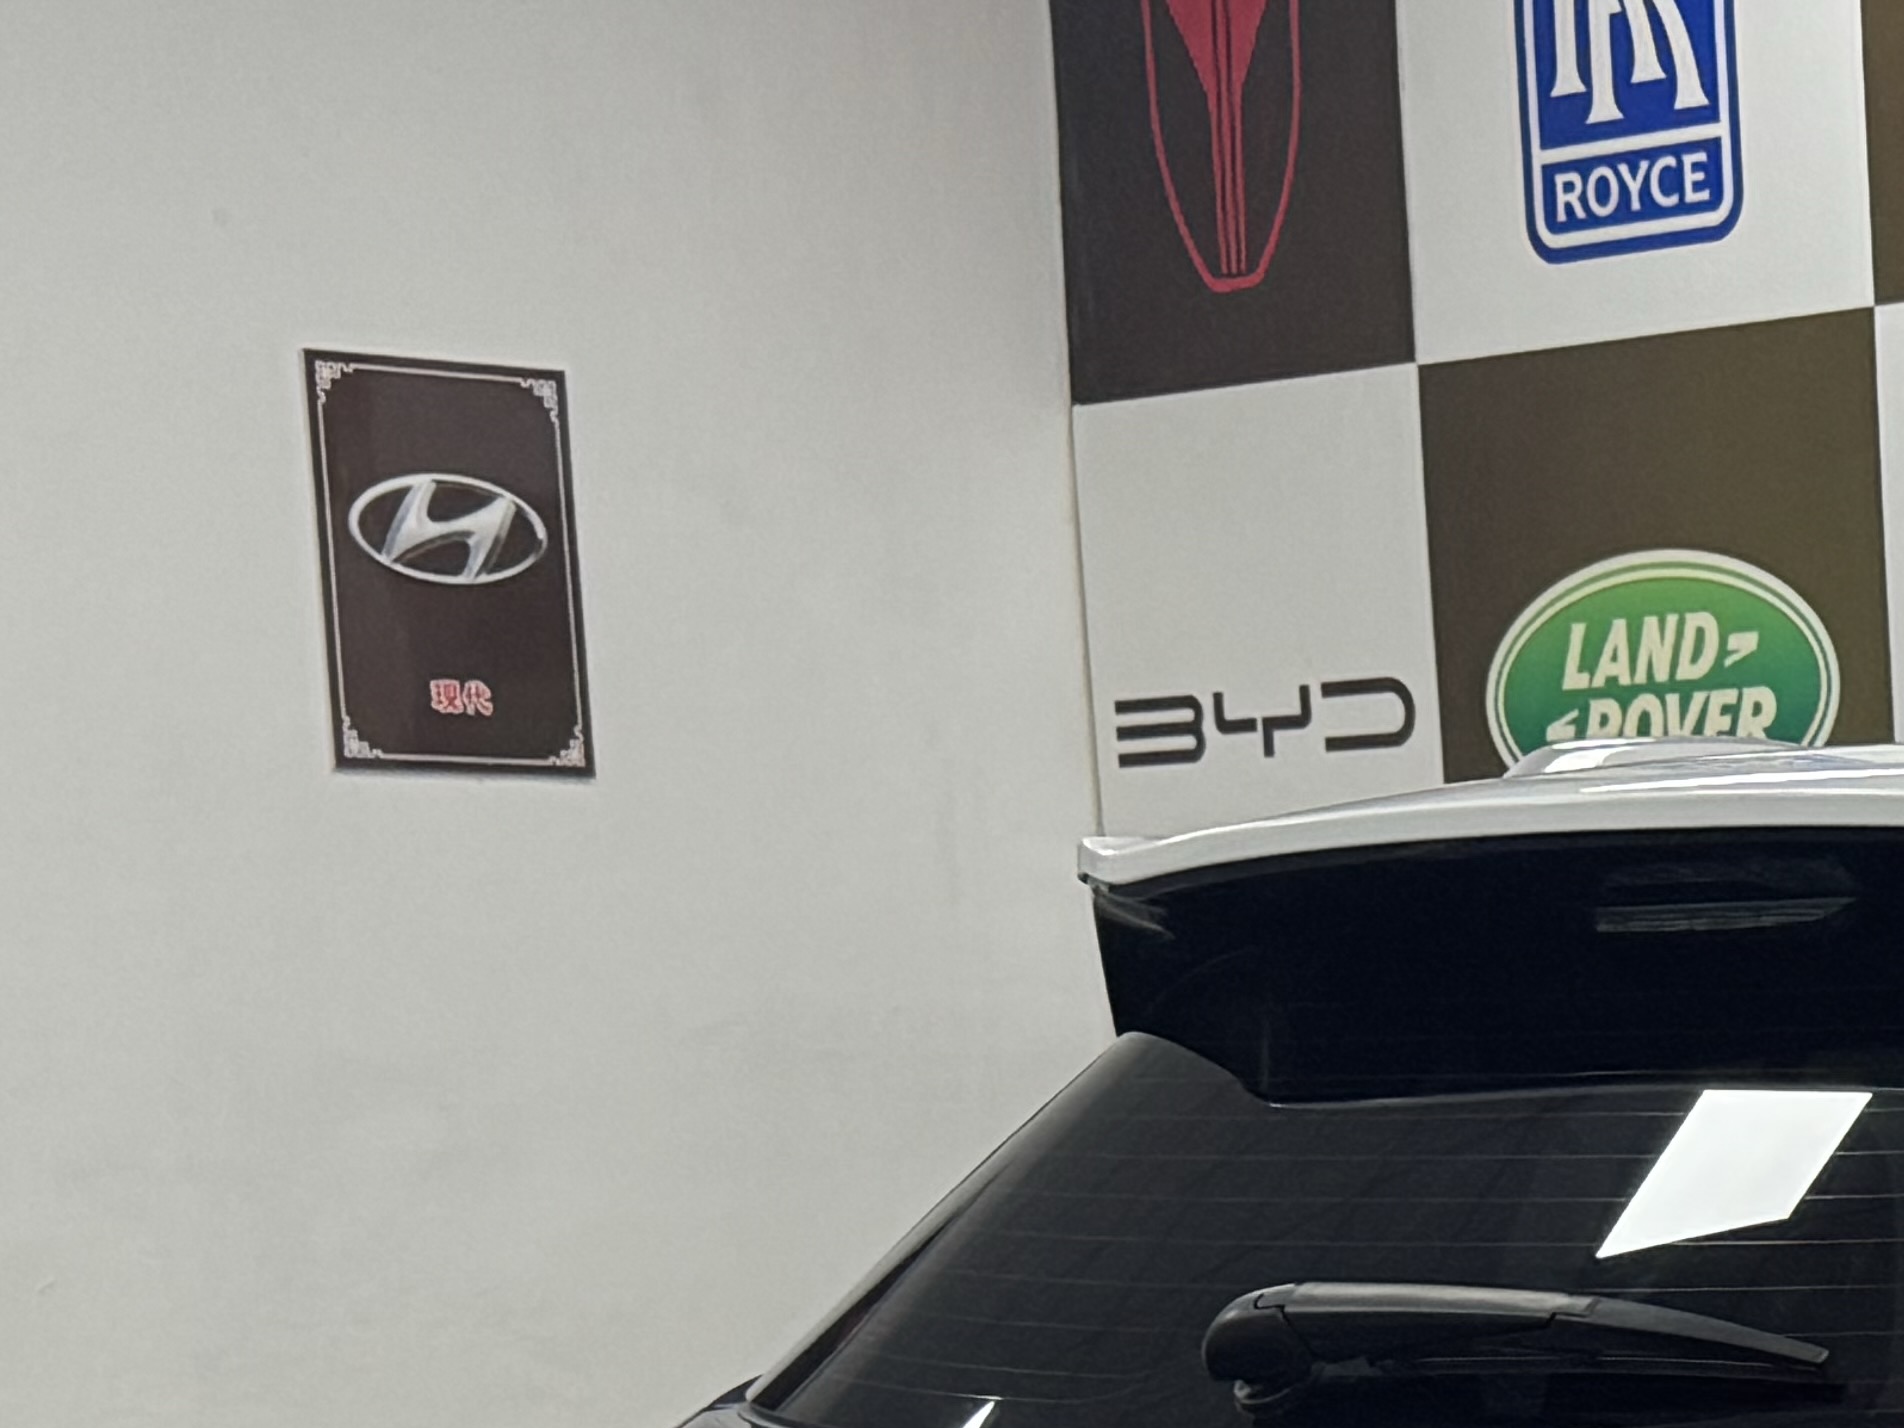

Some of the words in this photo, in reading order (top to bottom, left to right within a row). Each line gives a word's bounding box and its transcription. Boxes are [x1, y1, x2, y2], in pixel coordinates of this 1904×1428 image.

[1553, 151, 1711, 222] ROYCE
[1562, 611, 1720, 690] LAND
[429, 678, 494, 717] 现代
[1115, 677, 1416, 768] BYD
